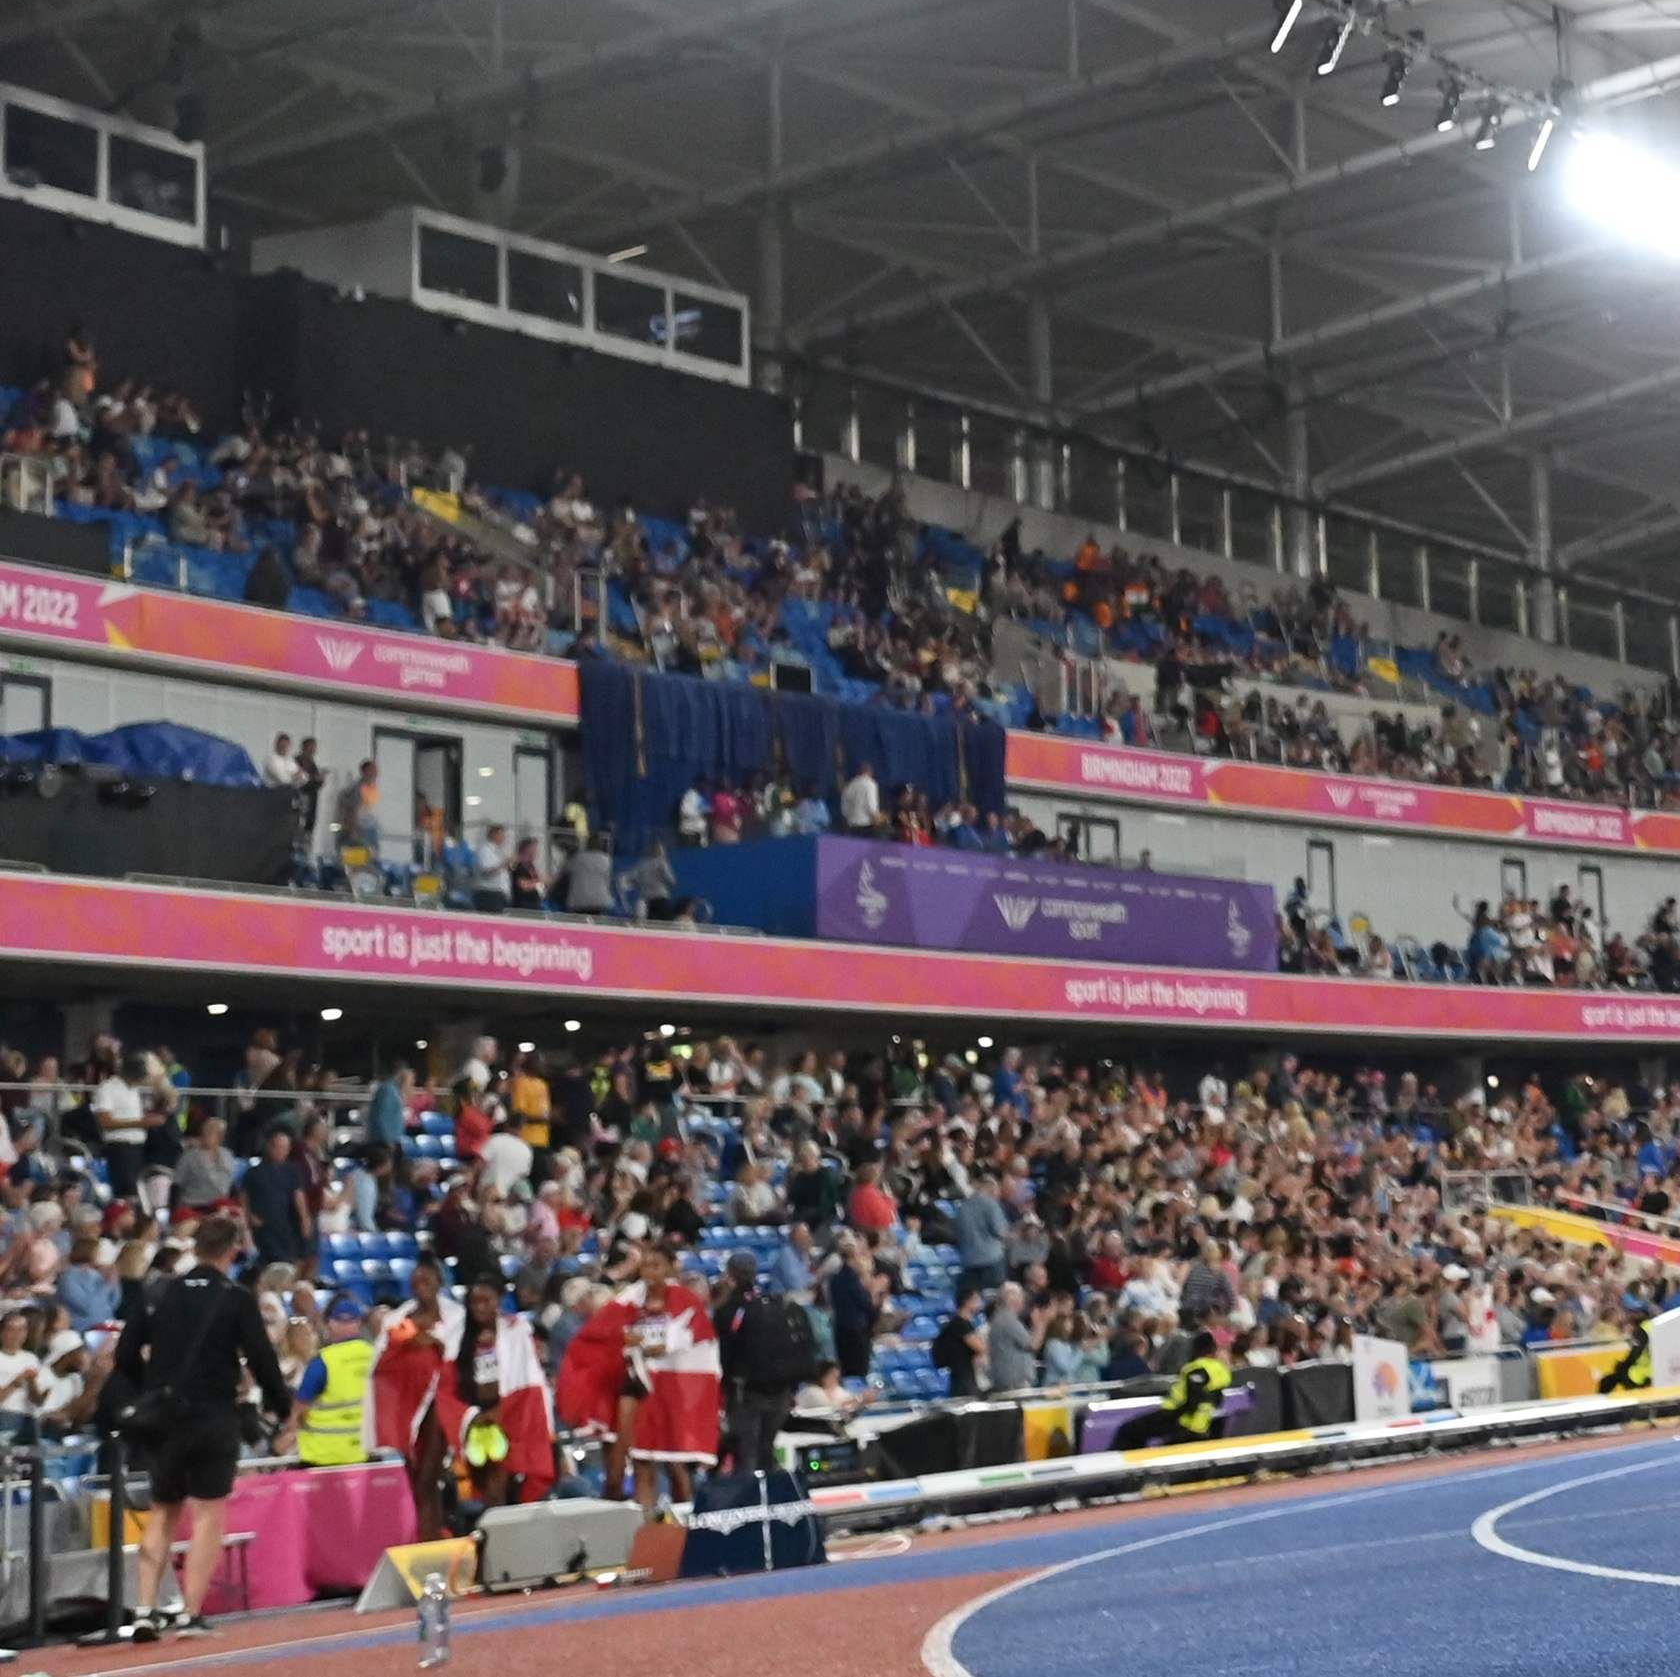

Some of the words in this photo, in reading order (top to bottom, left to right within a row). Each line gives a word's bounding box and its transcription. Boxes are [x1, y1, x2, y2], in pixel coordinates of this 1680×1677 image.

[22, 585, 79, 629] 2022
[1081, 753, 1158, 789] BIRMINGHAM
[1159, 763, 1193, 794] 2022
[321, 925, 385, 962] sport
[387, 923, 408, 960] is
[409, 925, 453, 967] just
[454, 928, 490, 965] the
[492, 931, 593, 982] beginning
[1065, 979, 1107, 1008] sport
[1106, 976, 1122, 1005] is
[1122, 976, 1150, 1011] just
[1151, 979, 1175, 1007] the
[1175, 979, 1248, 1016] beginning
